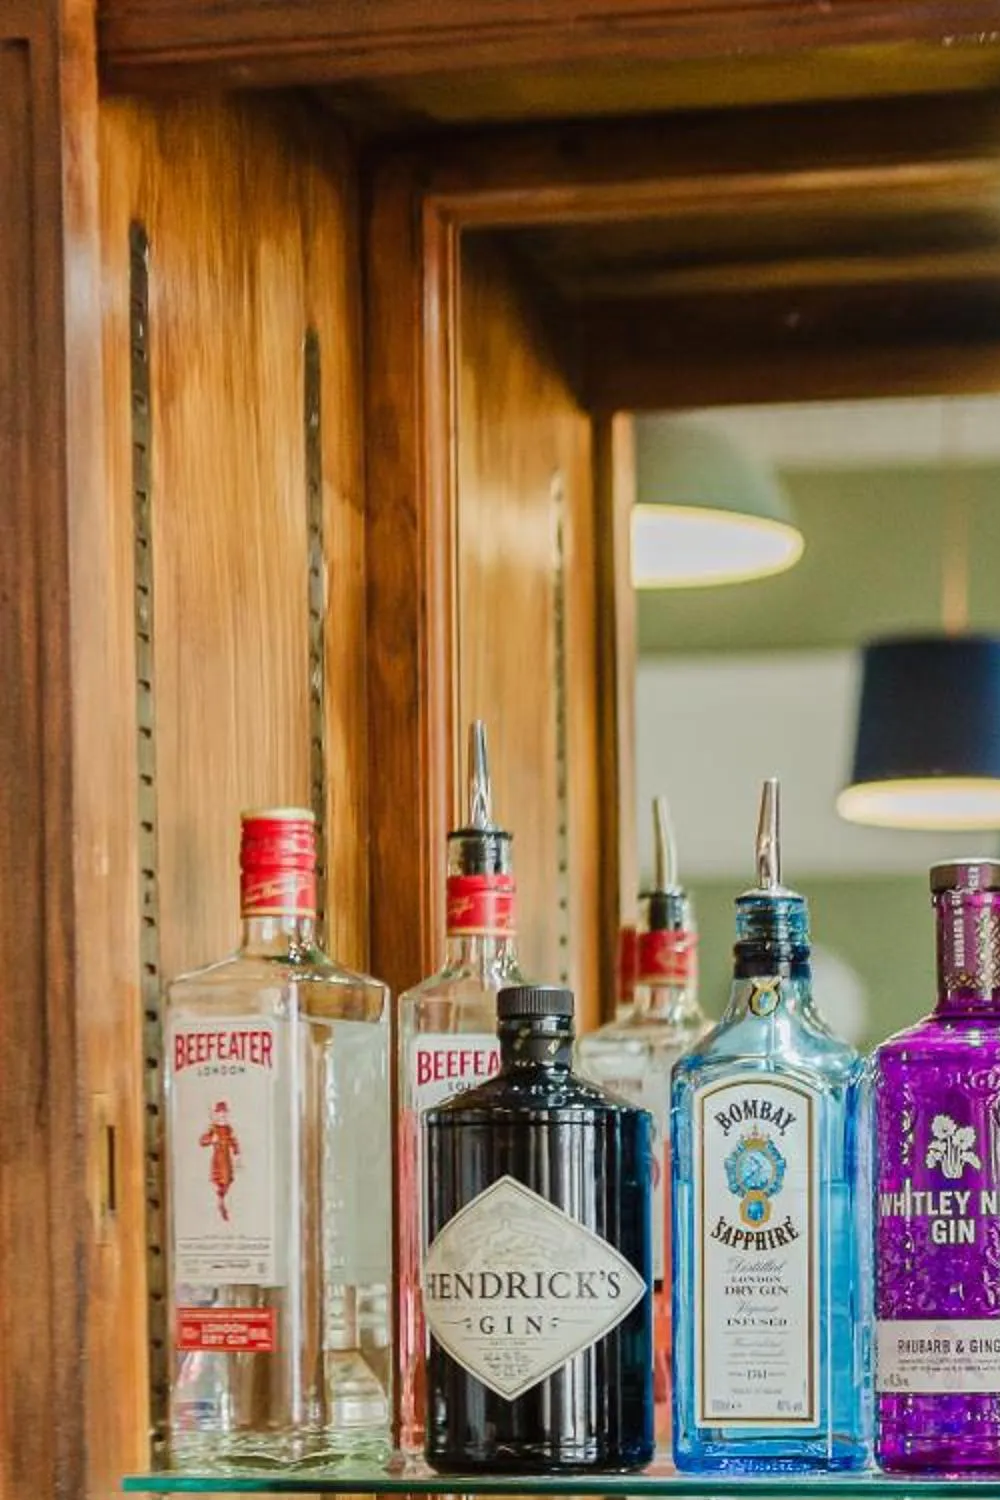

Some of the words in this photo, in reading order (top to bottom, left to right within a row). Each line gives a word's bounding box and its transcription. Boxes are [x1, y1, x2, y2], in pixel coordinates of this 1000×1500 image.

[175, 1031, 272, 1072] BEEFEATER
[416, 1050, 501, 1087] BEEFEA
[713, 1099, 797, 1136] BOMBAY
[880, 1191, 971, 1216] WHITLEY
[711, 1216, 800, 1250] SAPPHIRE
[932, 1219, 976, 1244] GIN
[428, 1271, 622, 1300] HENDRICK'S
[724, 1285, 755, 1296] DRY
[759, 1285, 790, 1296] GIN
[731, 1275, 781, 1283] LONDON
[479, 1315, 545, 1335] GIN
[727, 1318, 788, 1327] INFUSED
[897, 1339, 951, 1353] RHUBARB
[955, 1339, 965, 1352] &
